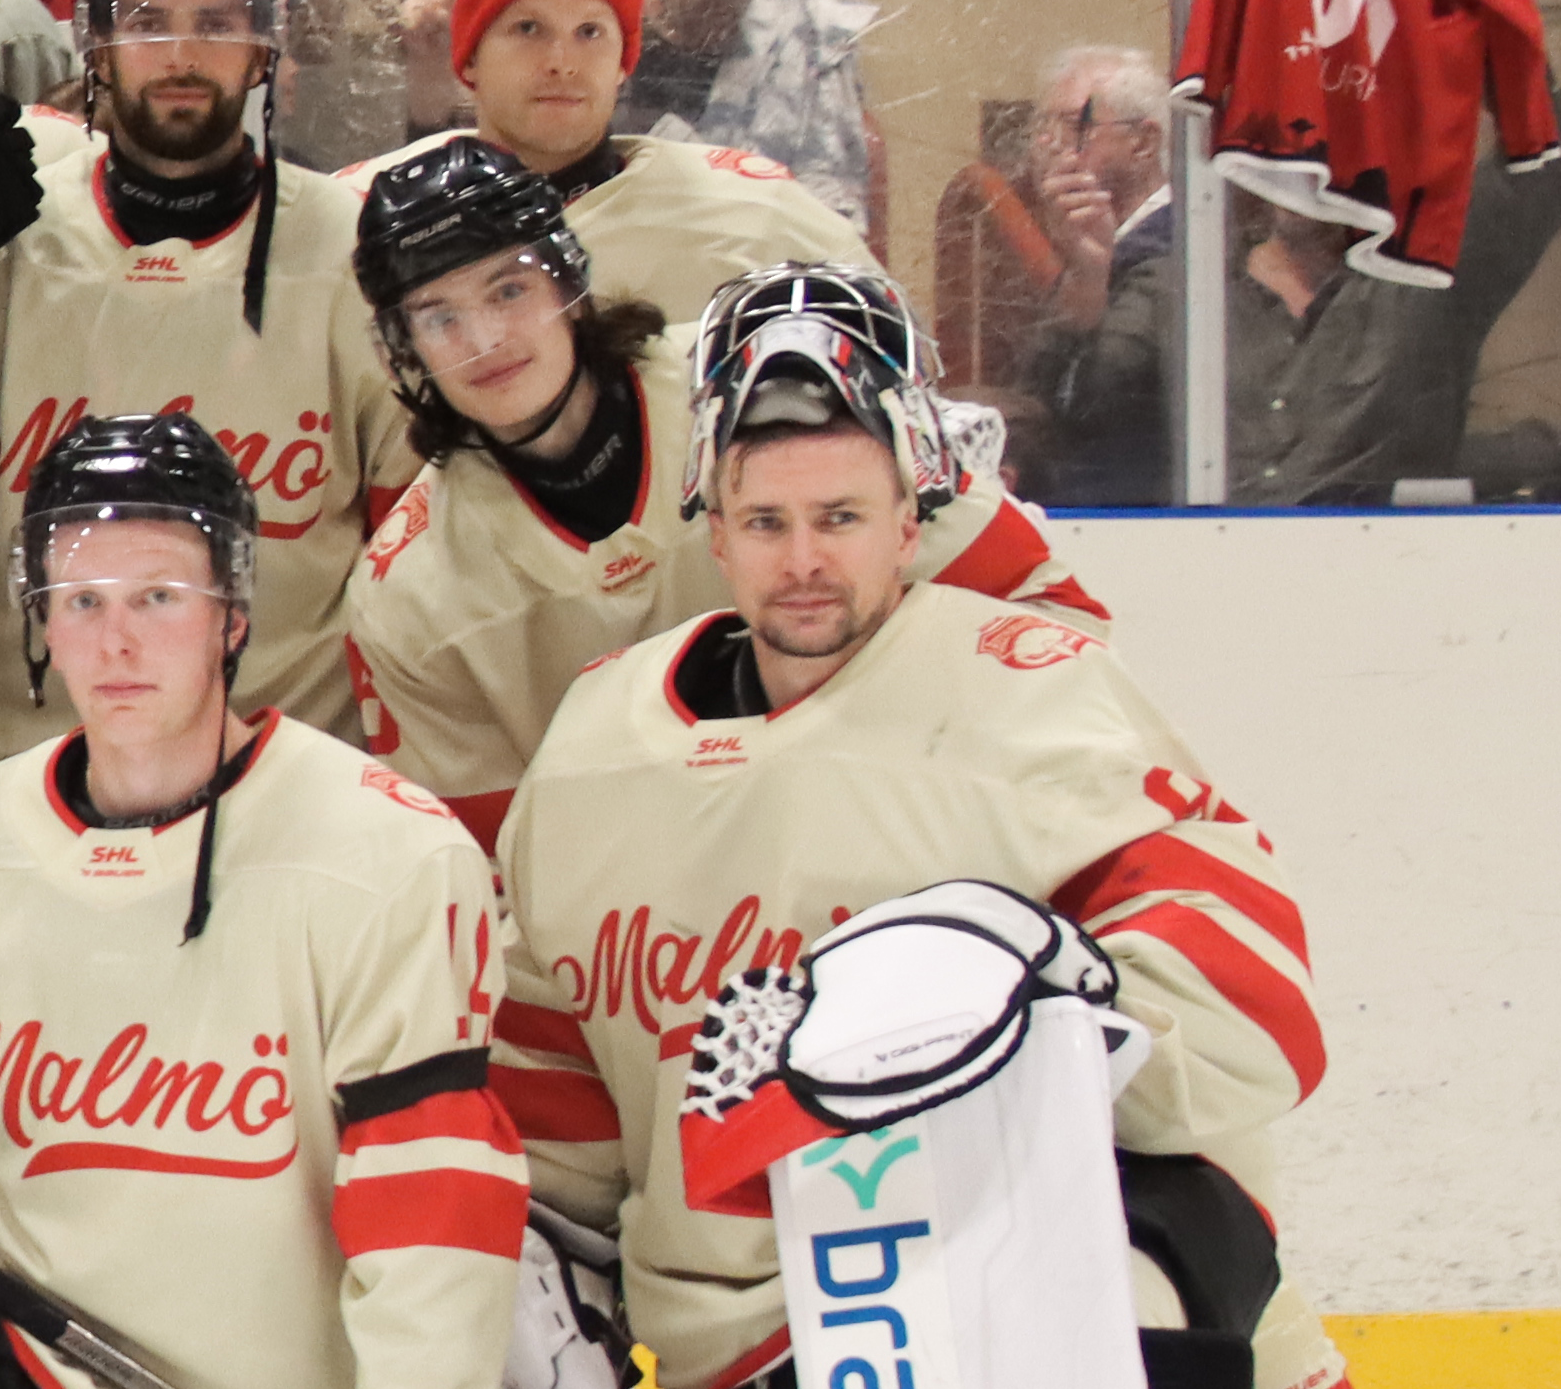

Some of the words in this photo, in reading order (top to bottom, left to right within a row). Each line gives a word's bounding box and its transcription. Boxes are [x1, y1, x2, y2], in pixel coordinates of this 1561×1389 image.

[134, 256, 180, 272] SHL
[694, 735, 743, 755] SHL
[89, 845, 139, 862] SHL
